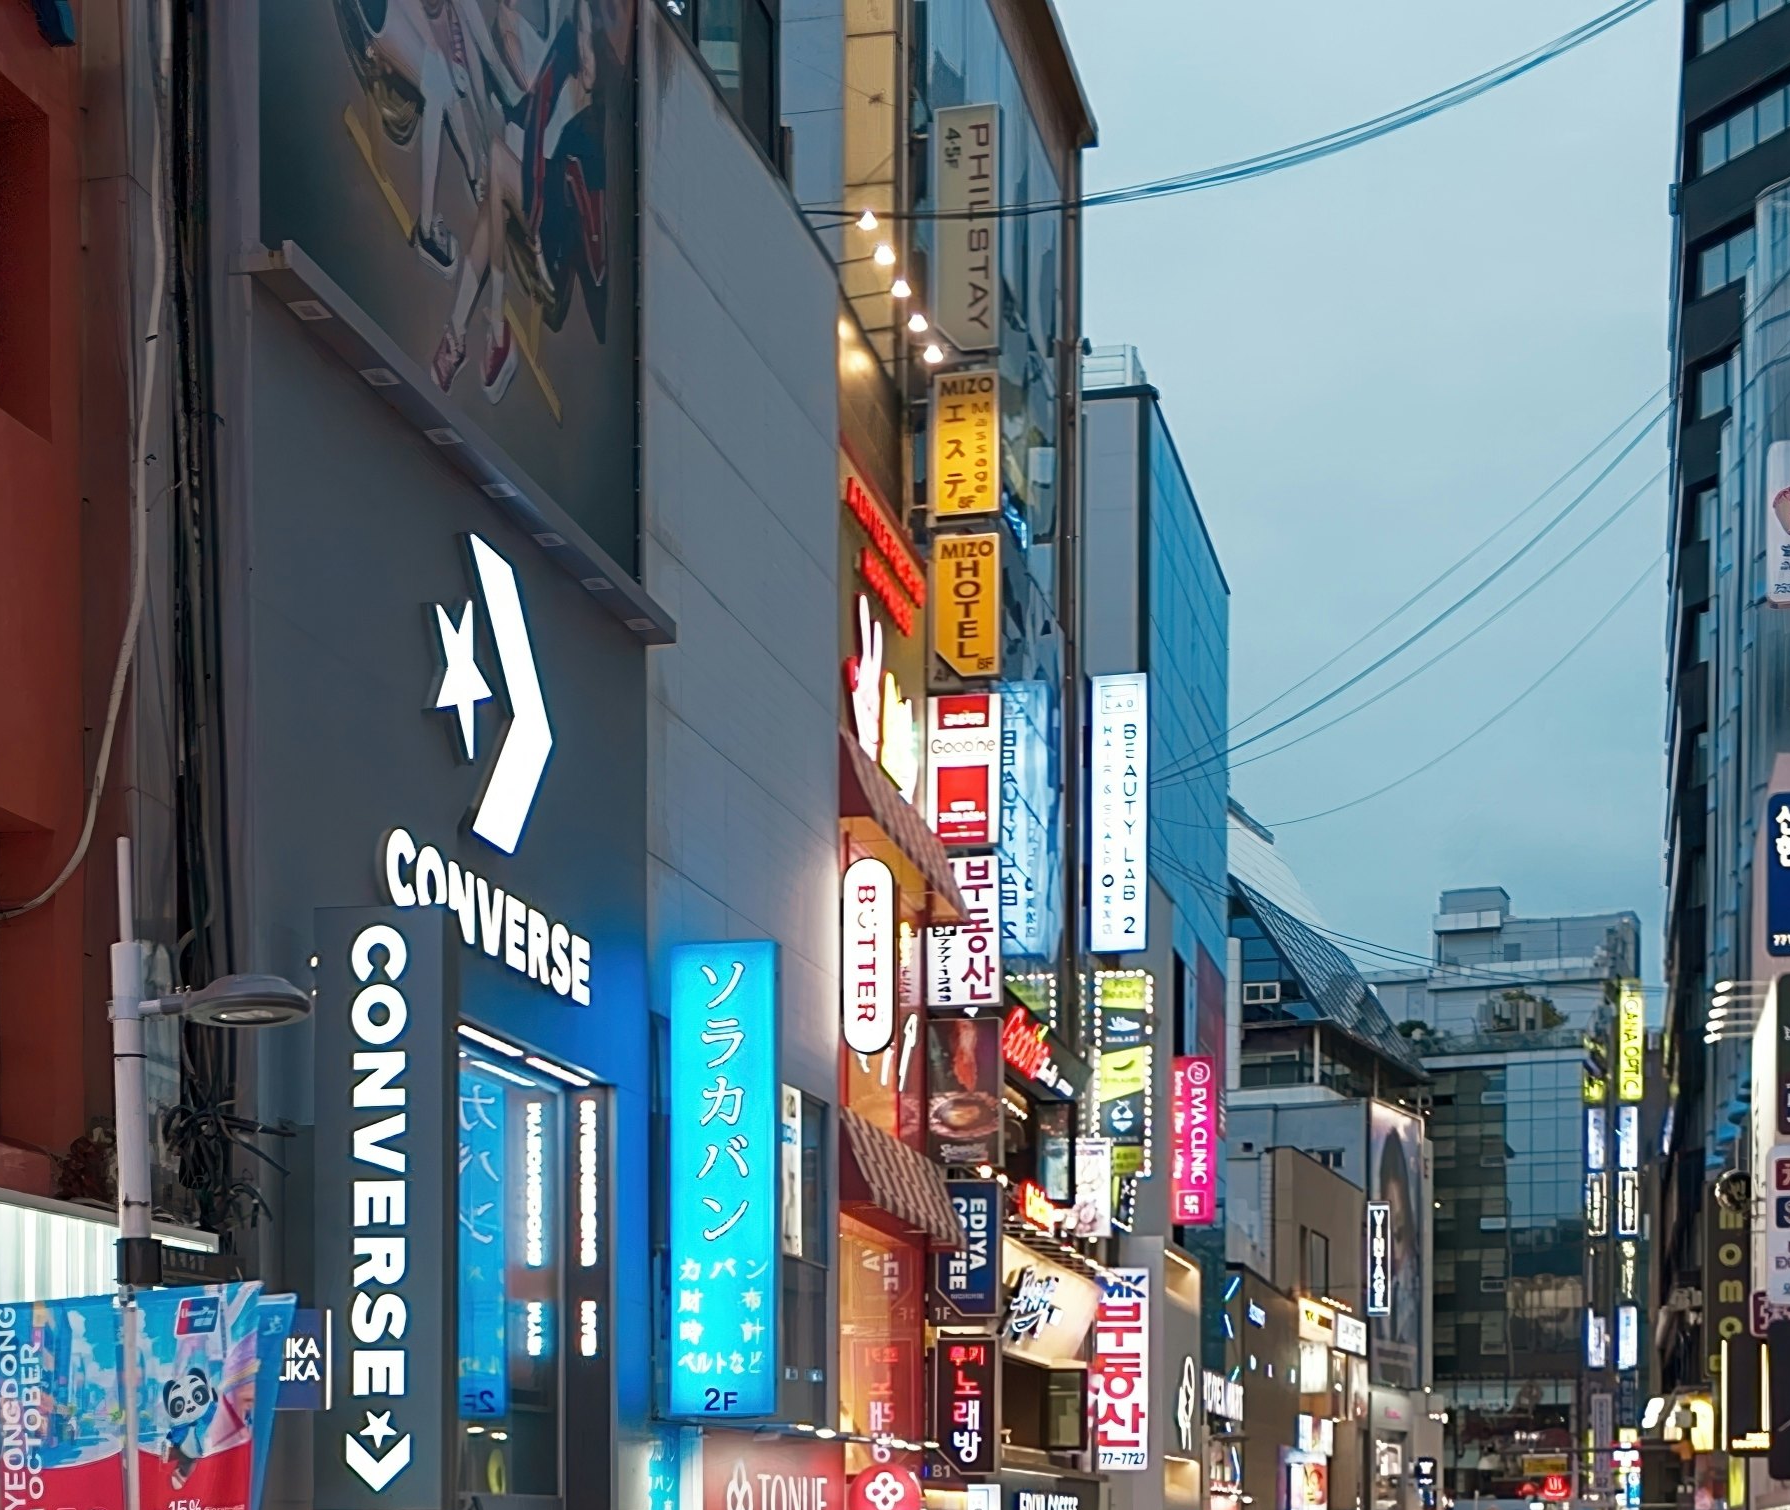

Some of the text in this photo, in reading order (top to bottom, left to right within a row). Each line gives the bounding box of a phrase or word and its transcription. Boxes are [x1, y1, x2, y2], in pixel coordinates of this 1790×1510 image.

[967, 122, 990, 331] PHILSTAY
[940, 376, 994, 397] MIZO
[943, 403, 966, 499] エステ
[940, 540, 995, 560] MIZO
[952, 559, 982, 659] HOTEL
[385, 827, 591, 1008] CONVERSE
[960, 859, 996, 1001] 부동산
[1123, 916, 1136, 934] 2
[697, 960, 751, 1242] ソラカバン
[351, 924, 407, 1397] CONVERSE
[1190, 1127, 1208, 1186] CLINIC
[969, 1197, 988, 1271] EDIYA
[1183, 1194, 1200, 1215] 5F
[679, 1258, 768, 1283] カバン
[285, 1337, 321, 1359] IKA
[934, 1306, 952, 1321] 1F
[704, 1387, 739, 1411] 2F
[952, 1369, 982, 1464] 노래방
[1096, 1301, 1146, 1448] 부동산
[20, 1342, 45, 1500] OCTOBER
